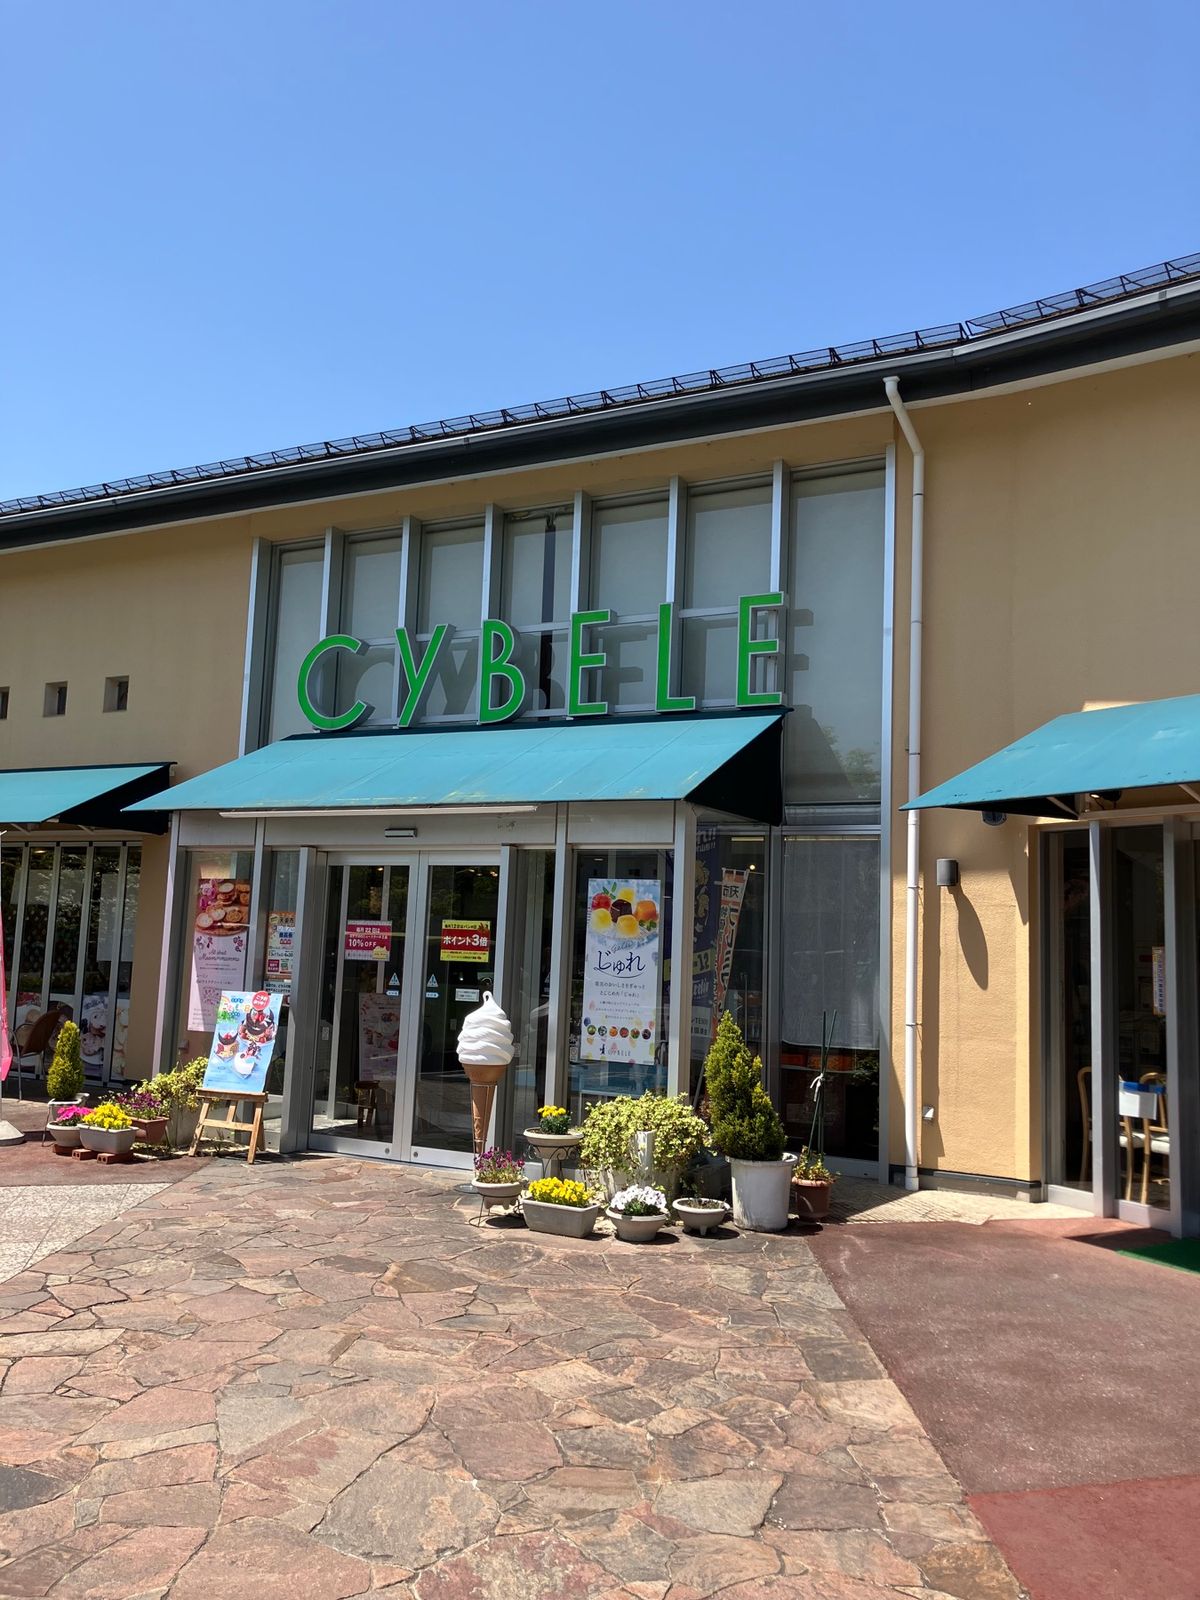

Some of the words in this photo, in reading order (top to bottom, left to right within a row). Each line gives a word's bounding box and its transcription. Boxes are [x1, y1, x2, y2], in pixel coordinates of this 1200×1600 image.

[297, 591, 786, 732] CYBELE
[443, 934, 488, 947] ポイント3倍
[598, 950, 646, 975] じゅれ
